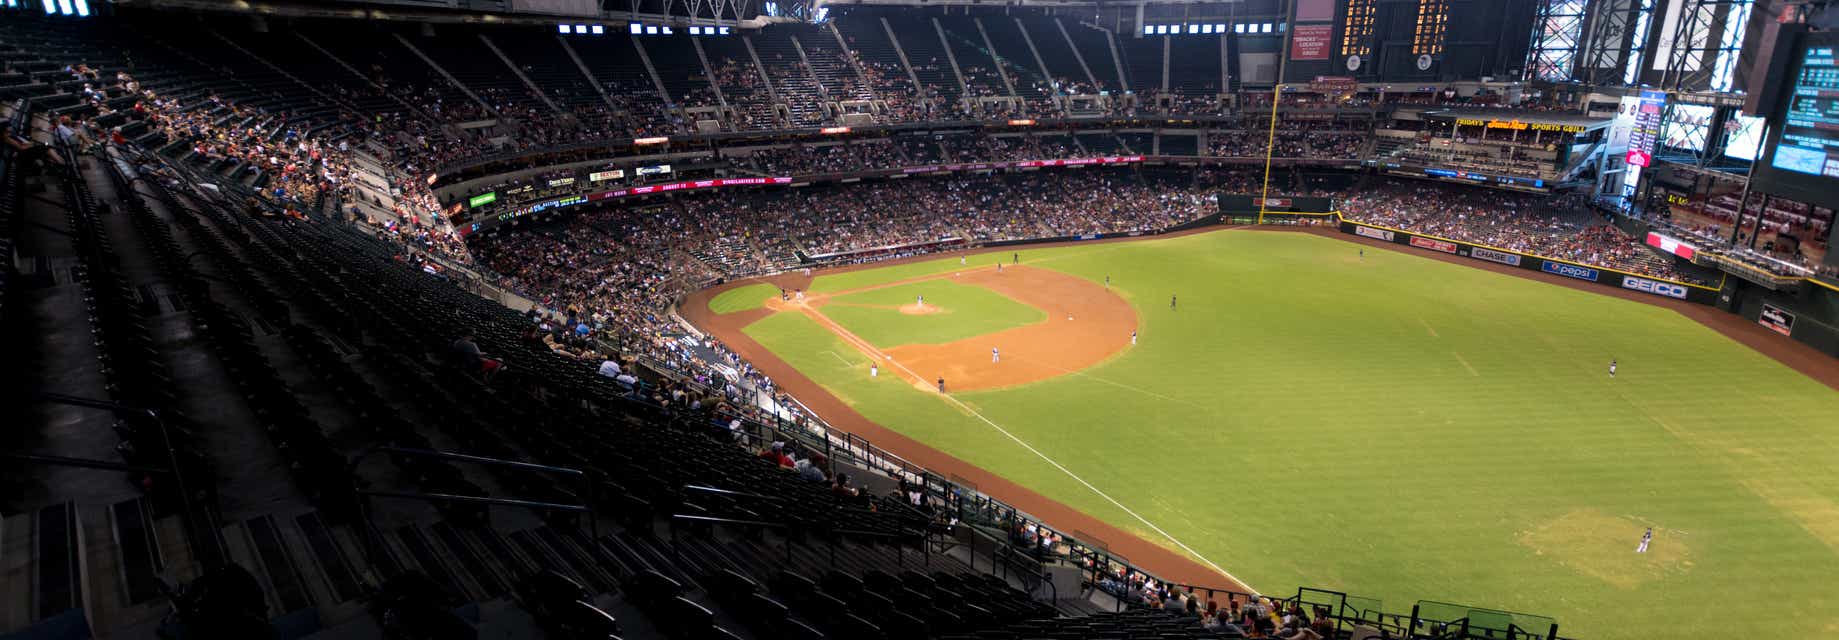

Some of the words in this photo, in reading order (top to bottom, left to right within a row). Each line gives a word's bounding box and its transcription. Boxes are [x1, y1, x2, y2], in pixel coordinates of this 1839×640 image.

[1531, 123, 1560, 131] SPORTS
[1563, 125, 1586, 133] GRILL
[1476, 249, 1506, 261] CHASE
[1560, 265, 1590, 278] pepsi
[1623, 276, 1687, 298] GEICO
